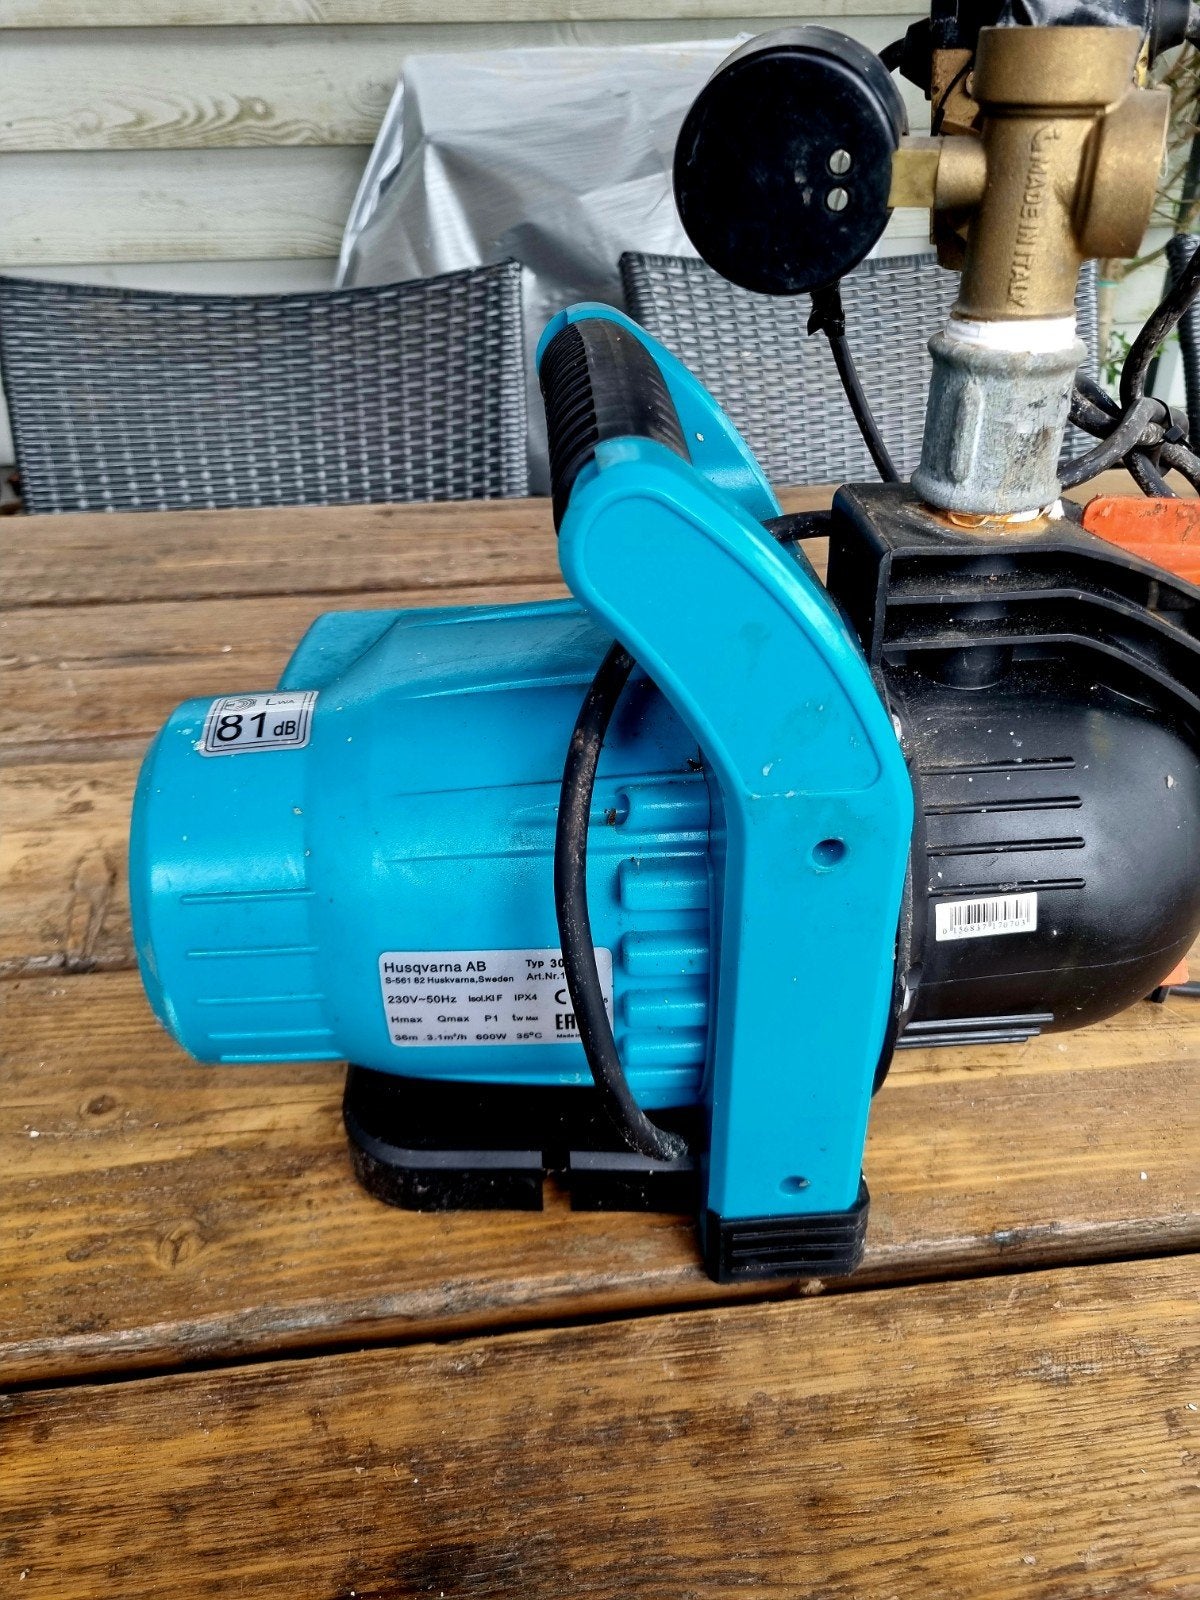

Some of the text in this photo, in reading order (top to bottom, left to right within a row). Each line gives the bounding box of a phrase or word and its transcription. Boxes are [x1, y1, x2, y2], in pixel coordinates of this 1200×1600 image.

[1007, 157, 1049, 309] MADE IN ITALY
[216, 711, 297, 742] 81 dB
[384, 960, 487, 975] Husqvarna AB
[525, 958, 565, 969] Typ 30
[385, 976, 412, 984] S-561
[414, 976, 426, 984] 82
[514, 993, 538, 1002] IPX4
[390, 1015, 423, 1023] Hmax
[437, 1014, 470, 1023] Qmax
[484, 1014, 499, 1022] P1
[476, 1033, 507, 1041] 600W
